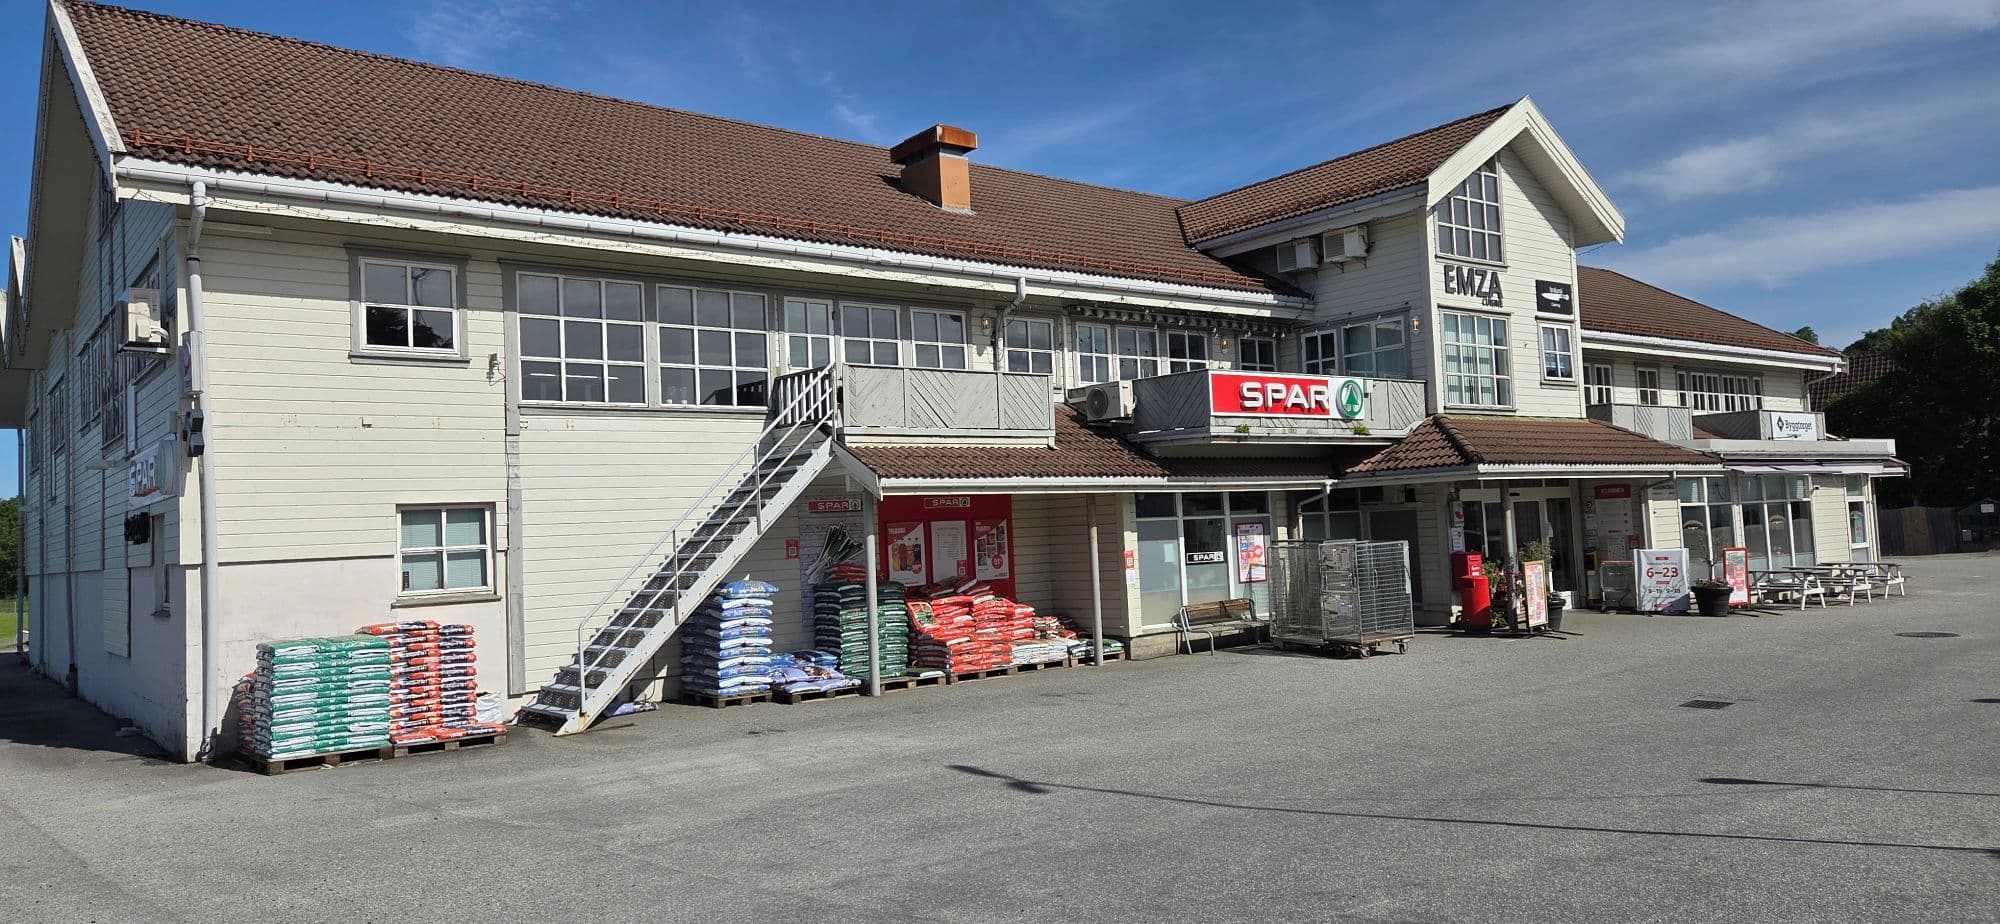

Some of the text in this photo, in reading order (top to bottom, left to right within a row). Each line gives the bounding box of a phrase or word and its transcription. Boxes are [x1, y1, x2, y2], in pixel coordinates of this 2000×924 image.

[1443, 264, 1504, 300] EMZA
[1240, 381, 1329, 410] SPAR
[130, 456, 156, 497] SPAR
[817, 501, 849, 511] SPAR
[932, 499, 960, 507] SPAR
[1193, 553, 1215, 561] SPAR
